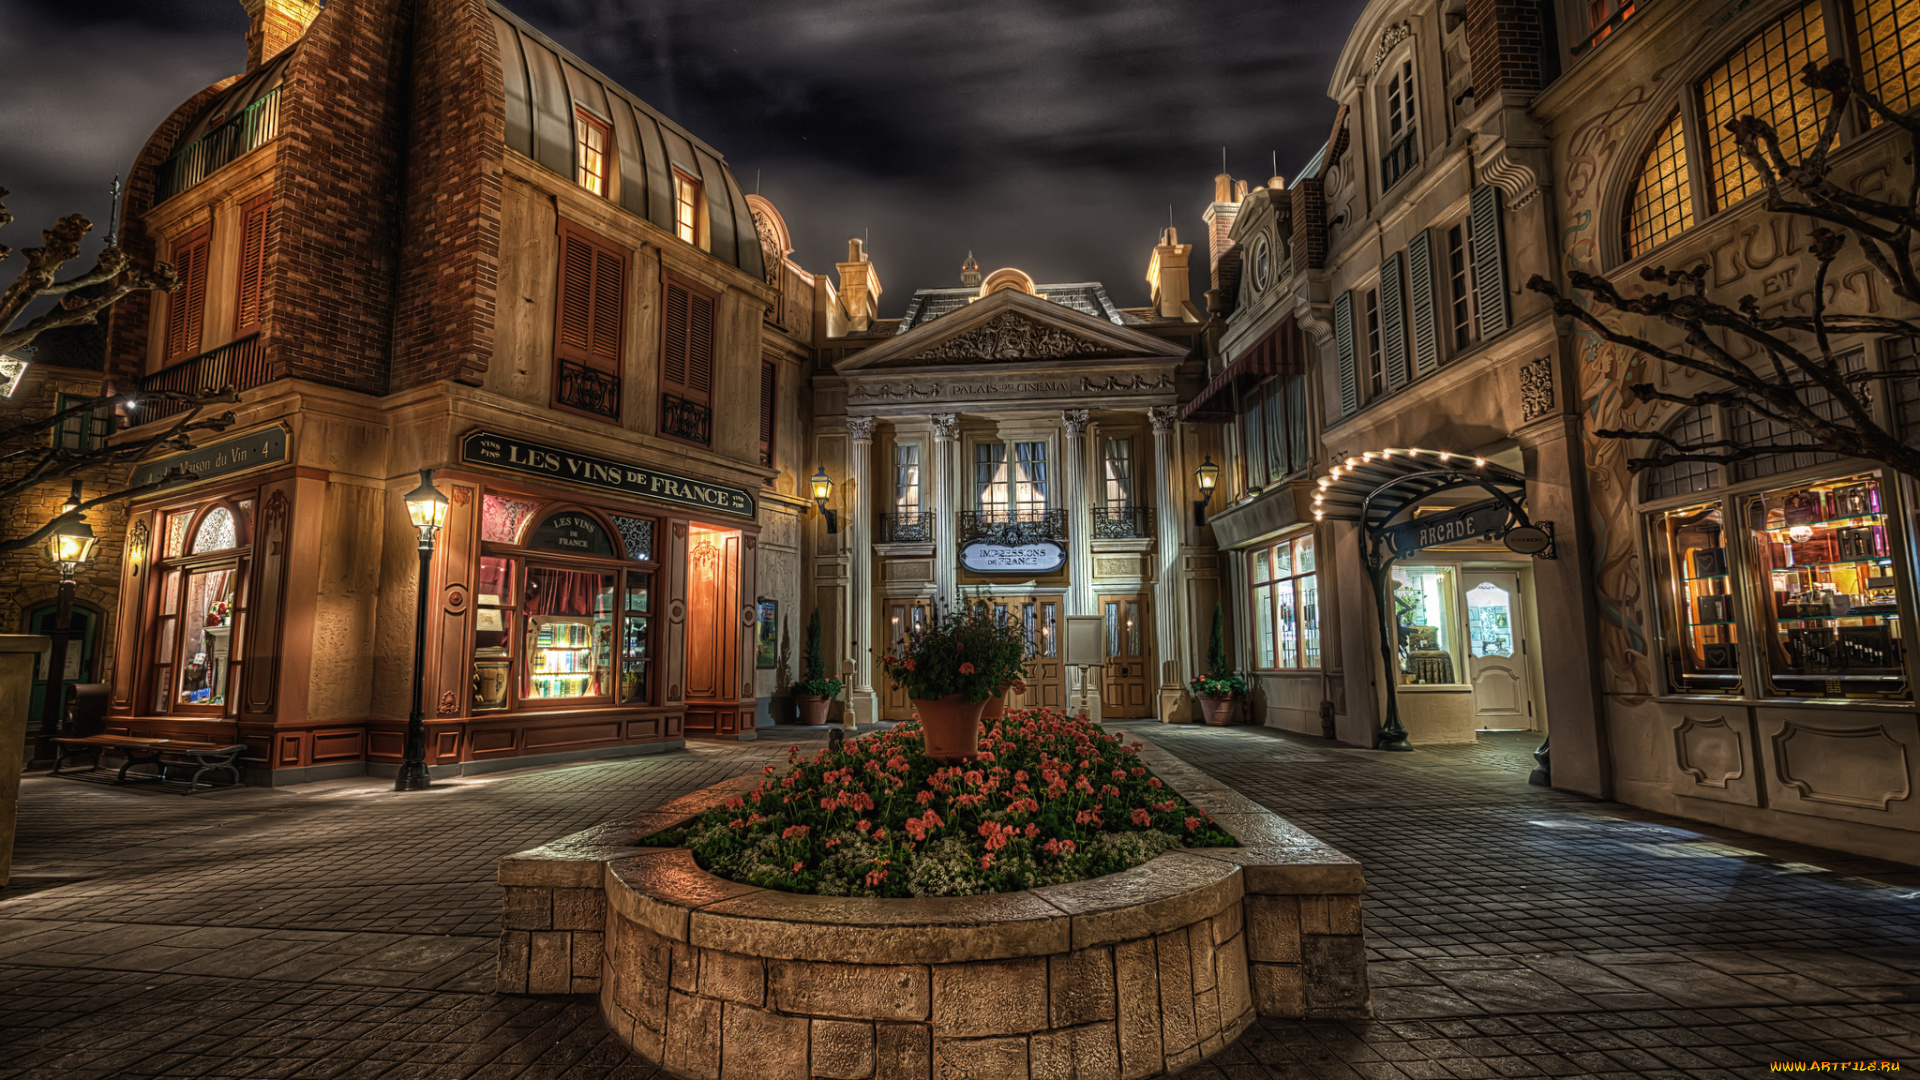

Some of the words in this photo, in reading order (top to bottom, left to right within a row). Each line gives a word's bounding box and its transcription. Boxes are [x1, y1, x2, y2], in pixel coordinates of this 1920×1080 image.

[1762, 267, 1796, 297] ET
[953, 384, 998, 395] PALAIS
[1017, 382, 1067, 392] CINEMA
[481, 440, 500, 450] VINS
[180, 460, 211, 474] Maison
[215, 452, 227, 468] du
[231, 447, 247, 463] Vin
[262, 440, 269, 458] 4
[509, 445, 560, 472] LES
[566, 457, 622, 485] VINS
[626, 471, 647, 485] DE
[650, 476, 729, 507] FRANCE
[553, 517, 571, 528] LES
[574, 517, 595, 533] VINS
[1420, 516, 1475, 546] ARCADE
[559, 537, 588, 548] FRANCE
[979, 549, 1046, 558] IMPRESSIONS
[998, 557, 1037, 566] FRANCE
